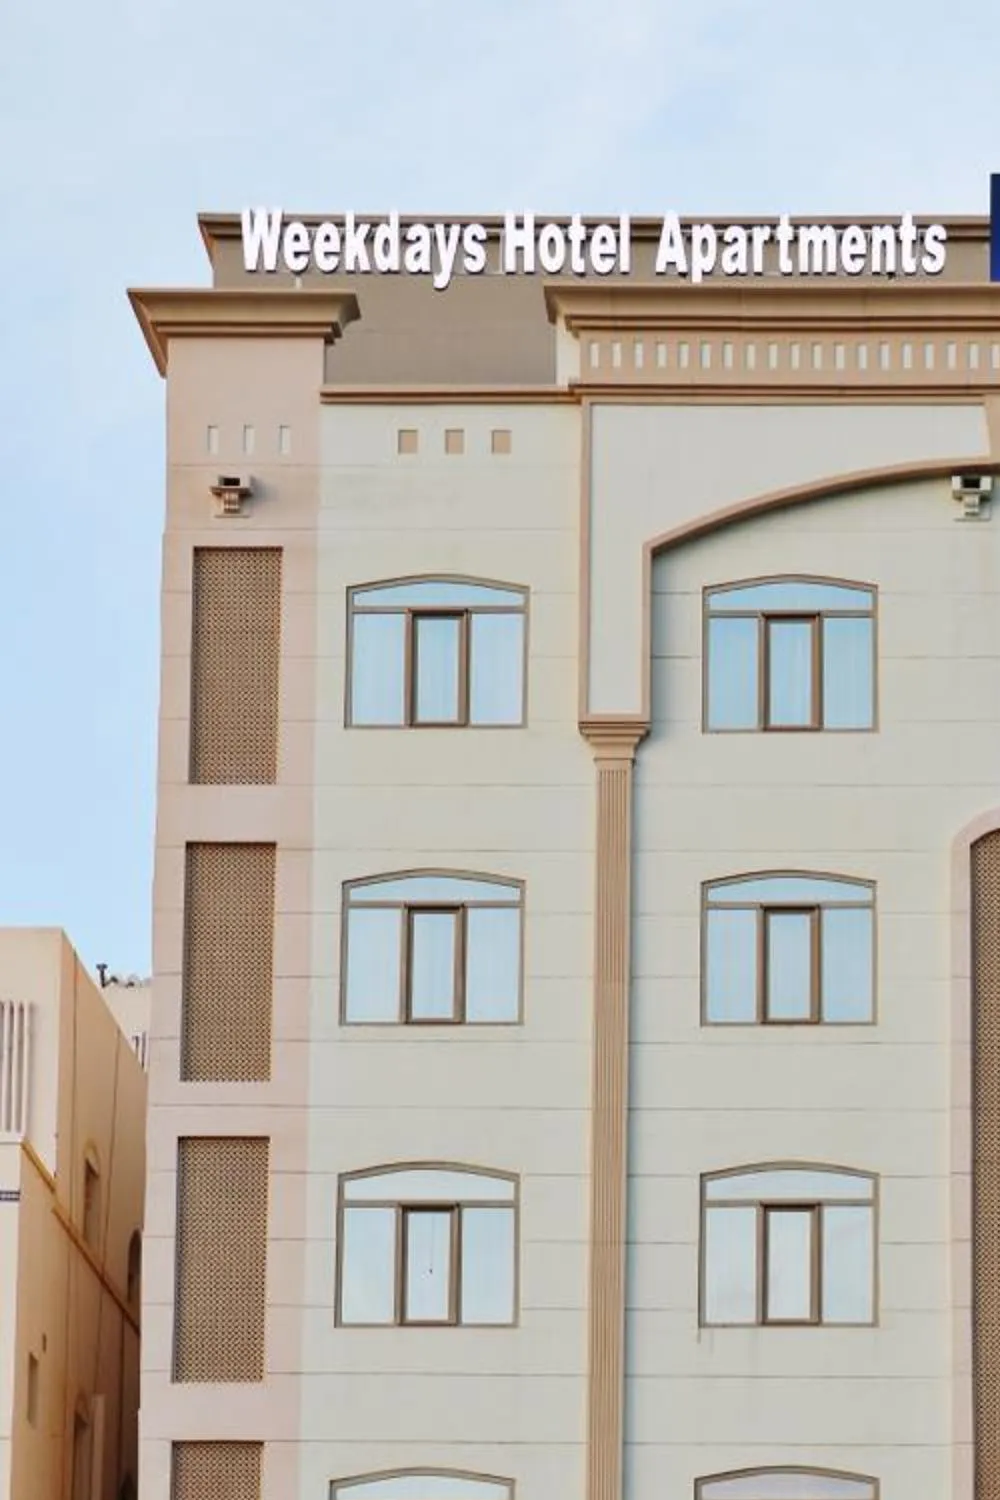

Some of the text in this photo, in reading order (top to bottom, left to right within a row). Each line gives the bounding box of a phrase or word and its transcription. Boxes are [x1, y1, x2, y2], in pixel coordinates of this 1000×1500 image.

[241, 207, 947, 289] Weekdays Hotel Apartments
